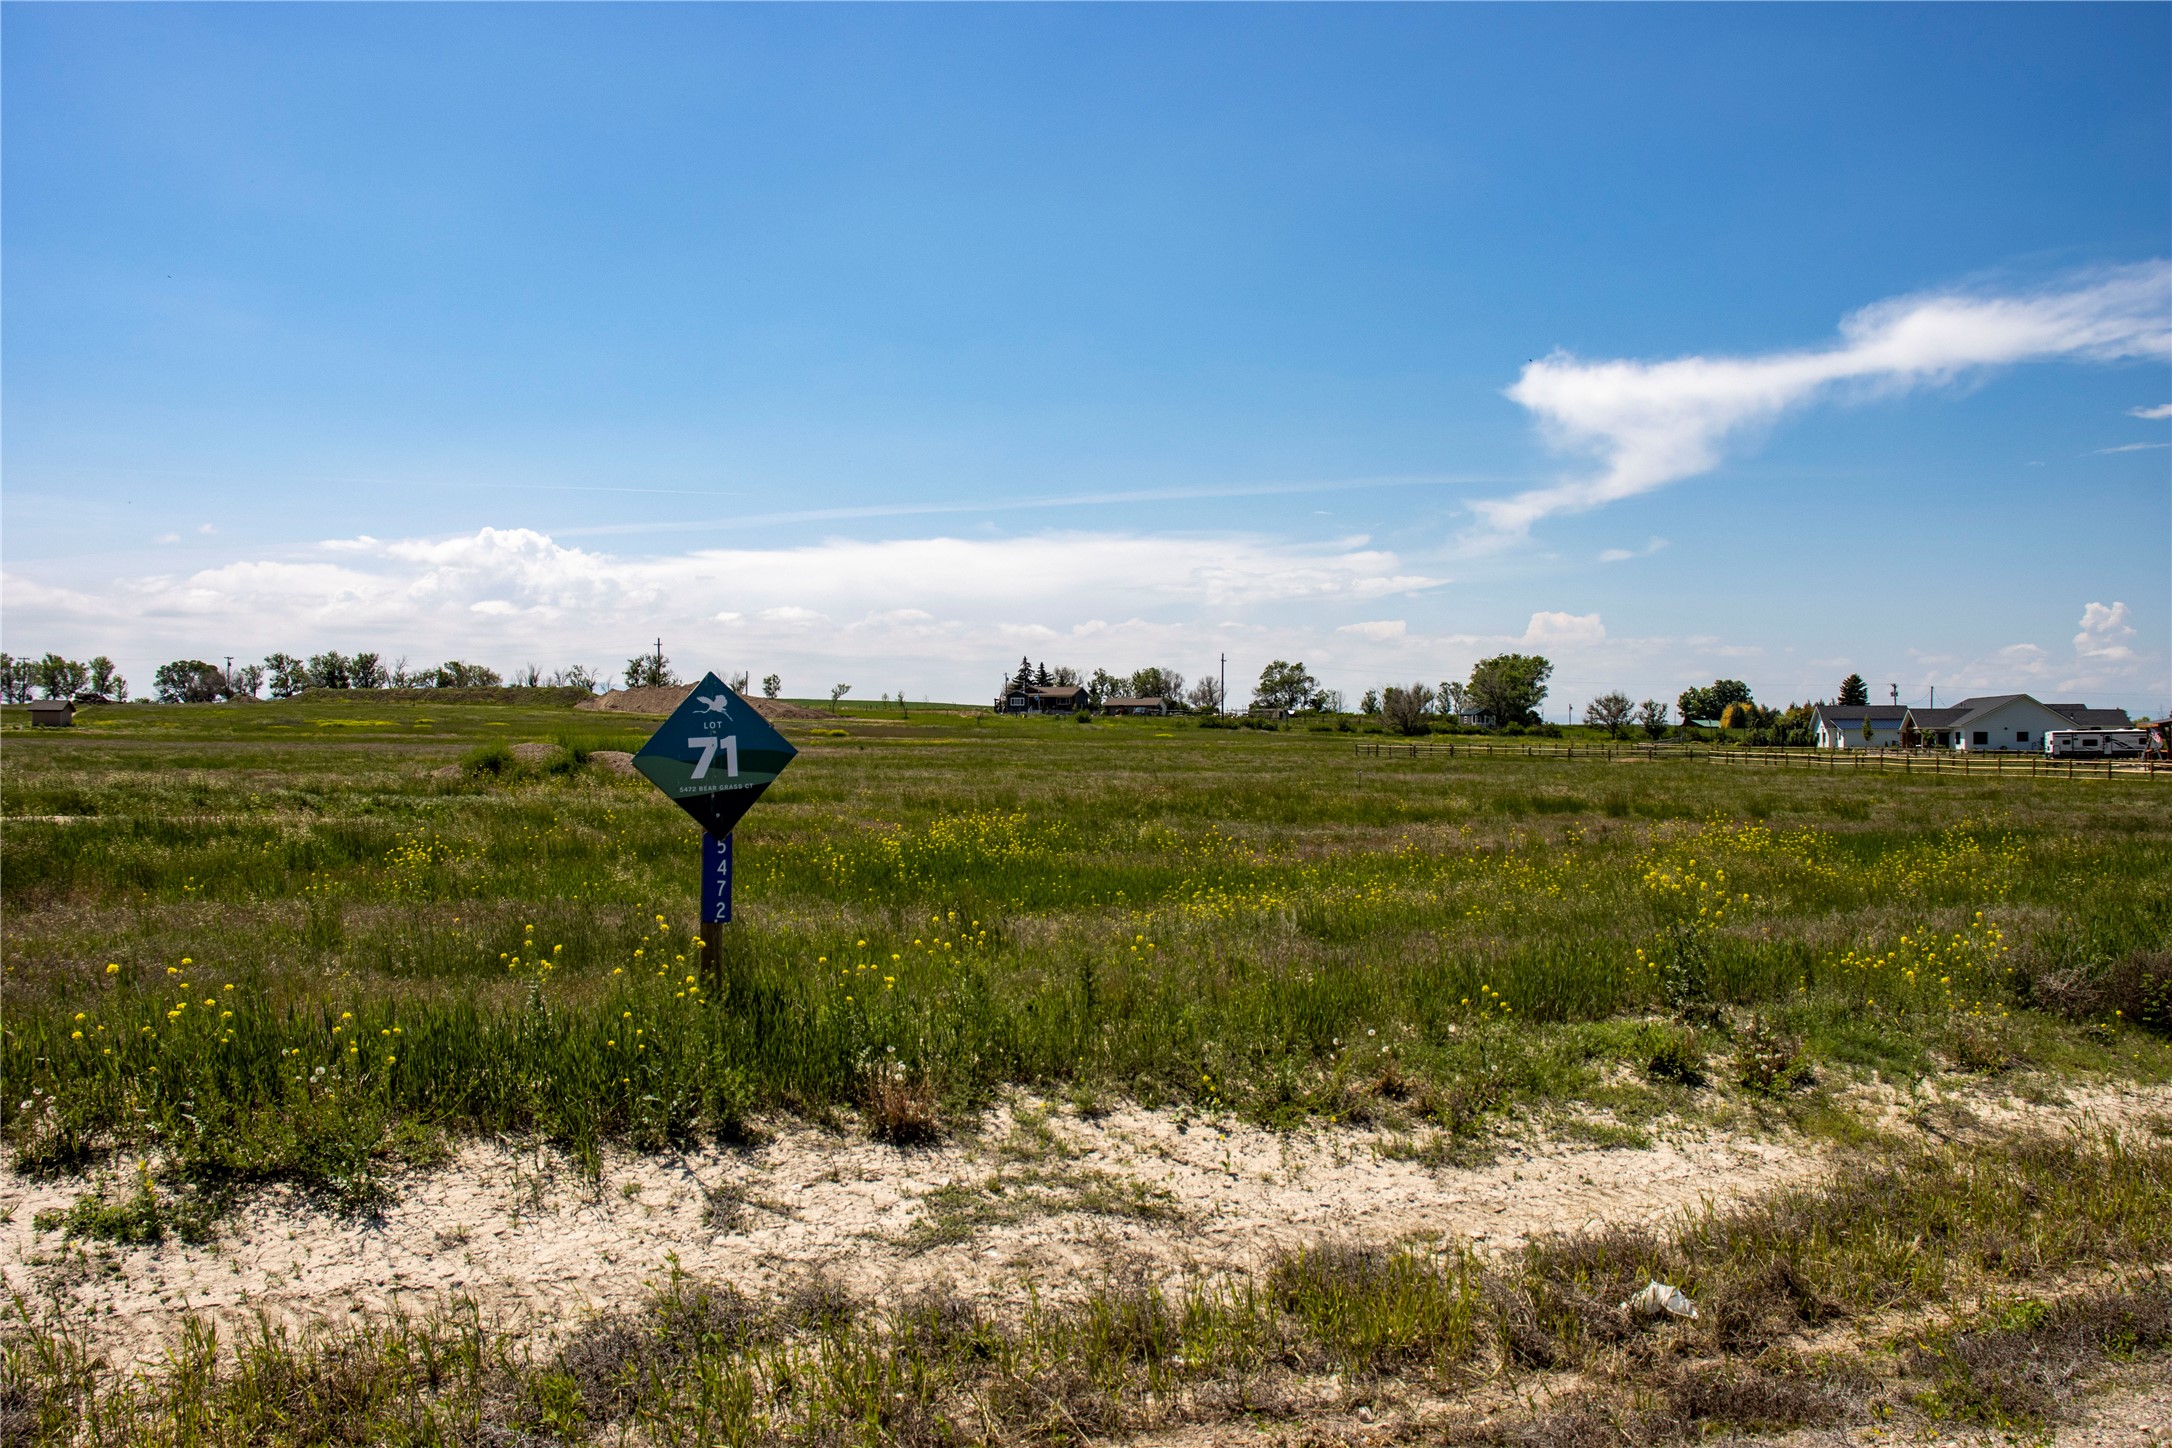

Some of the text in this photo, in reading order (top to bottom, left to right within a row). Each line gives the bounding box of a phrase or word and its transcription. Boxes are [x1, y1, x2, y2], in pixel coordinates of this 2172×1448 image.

[703, 721, 722, 730] LOT
[687, 735, 739, 780] 71
[719, 783, 743, 791] GRASS
[716, 840, 727, 919] 5472
